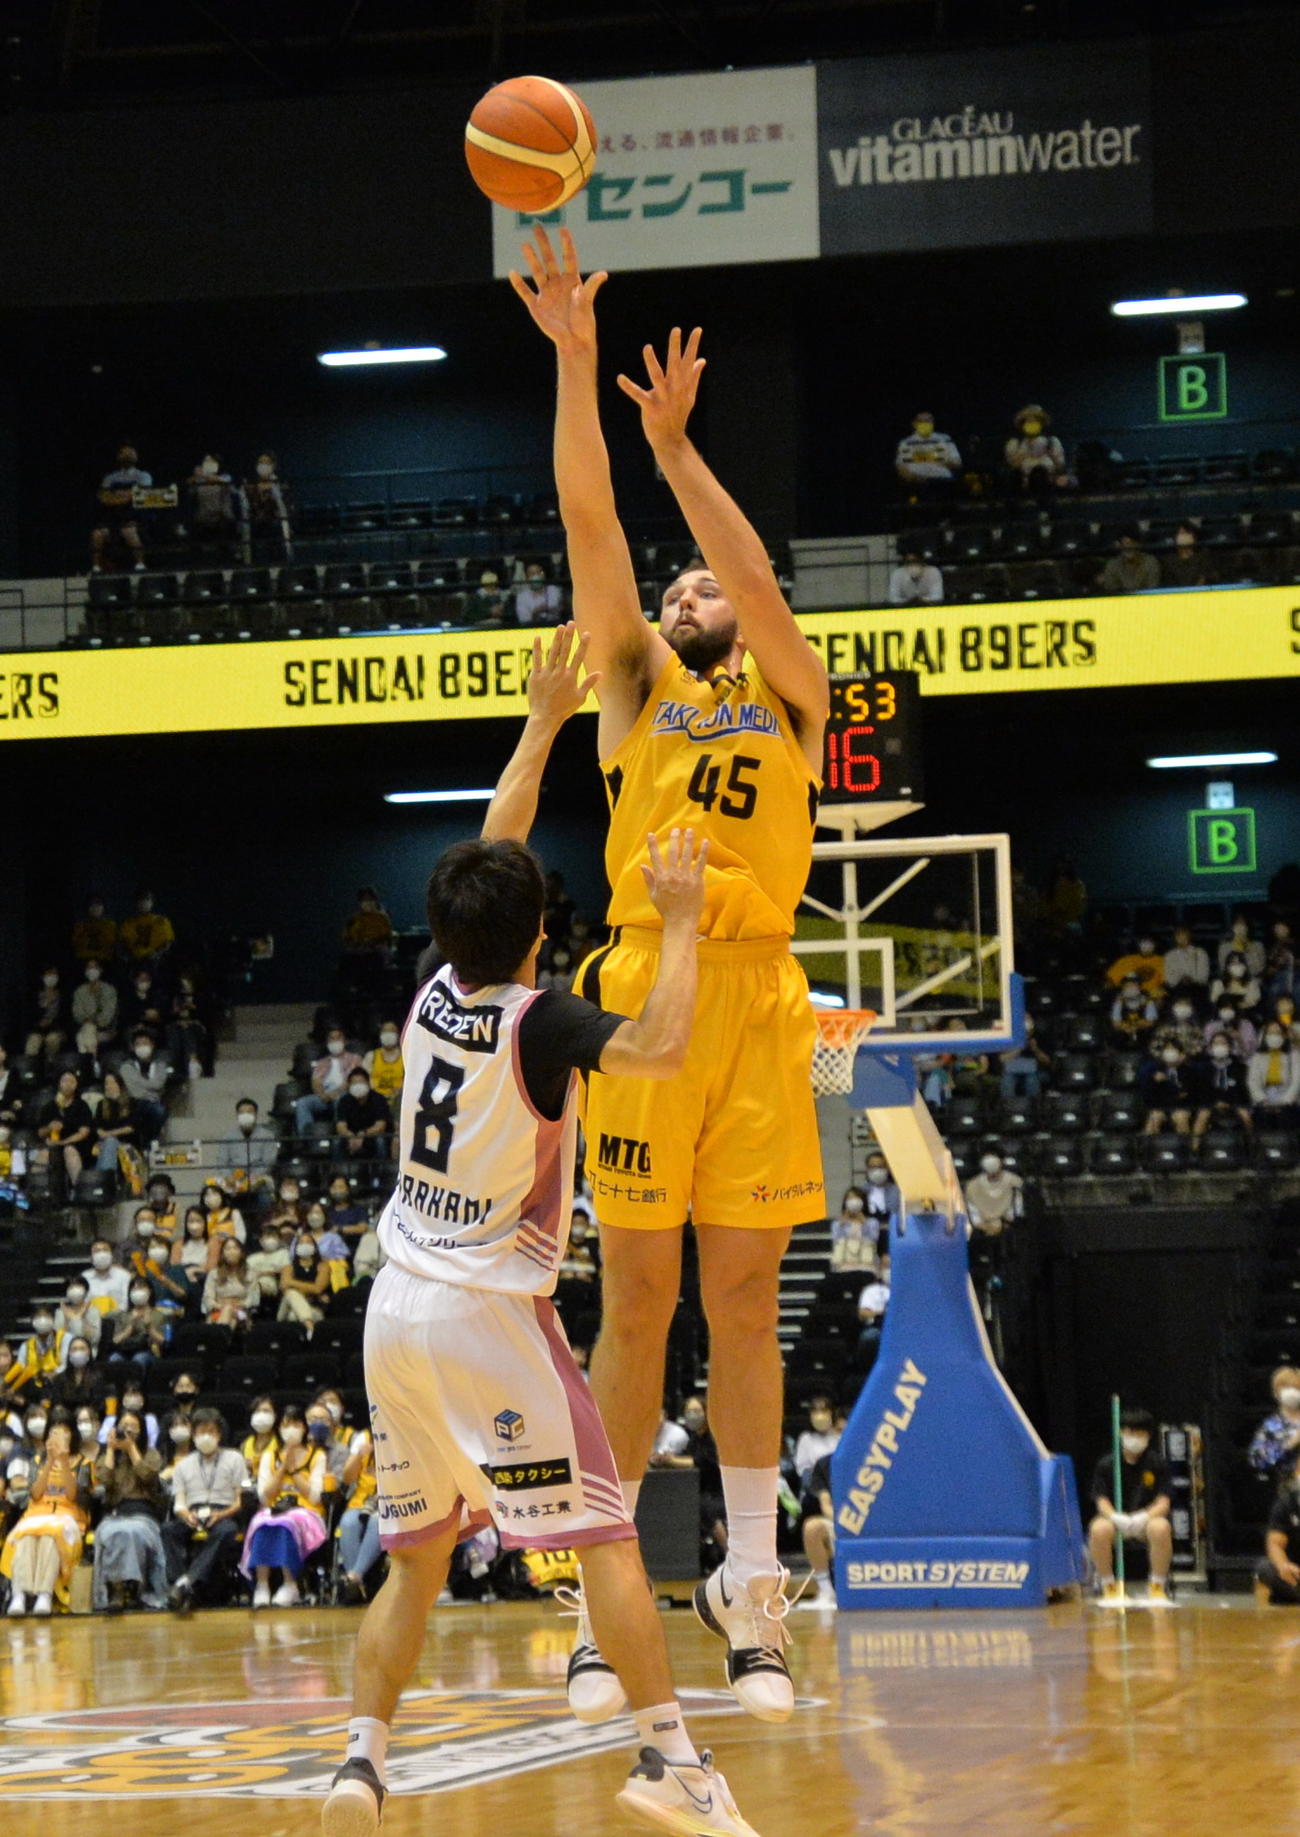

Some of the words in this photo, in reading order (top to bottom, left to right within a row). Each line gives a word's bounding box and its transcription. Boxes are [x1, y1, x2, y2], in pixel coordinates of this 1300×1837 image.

[829, 118, 1141, 187] vitaminwater
[584, 168, 792, 222] センコー
[1177, 365, 1208, 410] B
[960, 620, 1097, 671] 89ERS
[284, 654, 425, 707] SENDAI
[828, 726, 880, 792] 16
[687, 754, 761, 819] 45
[1208, 820, 1238, 863] B
[410, 1054, 467, 1174] 8
[598, 1132, 651, 1173] MTG
[400, 1171, 492, 1226] RAKAMI
[838, 1358, 928, 1536] EASYPLAY
